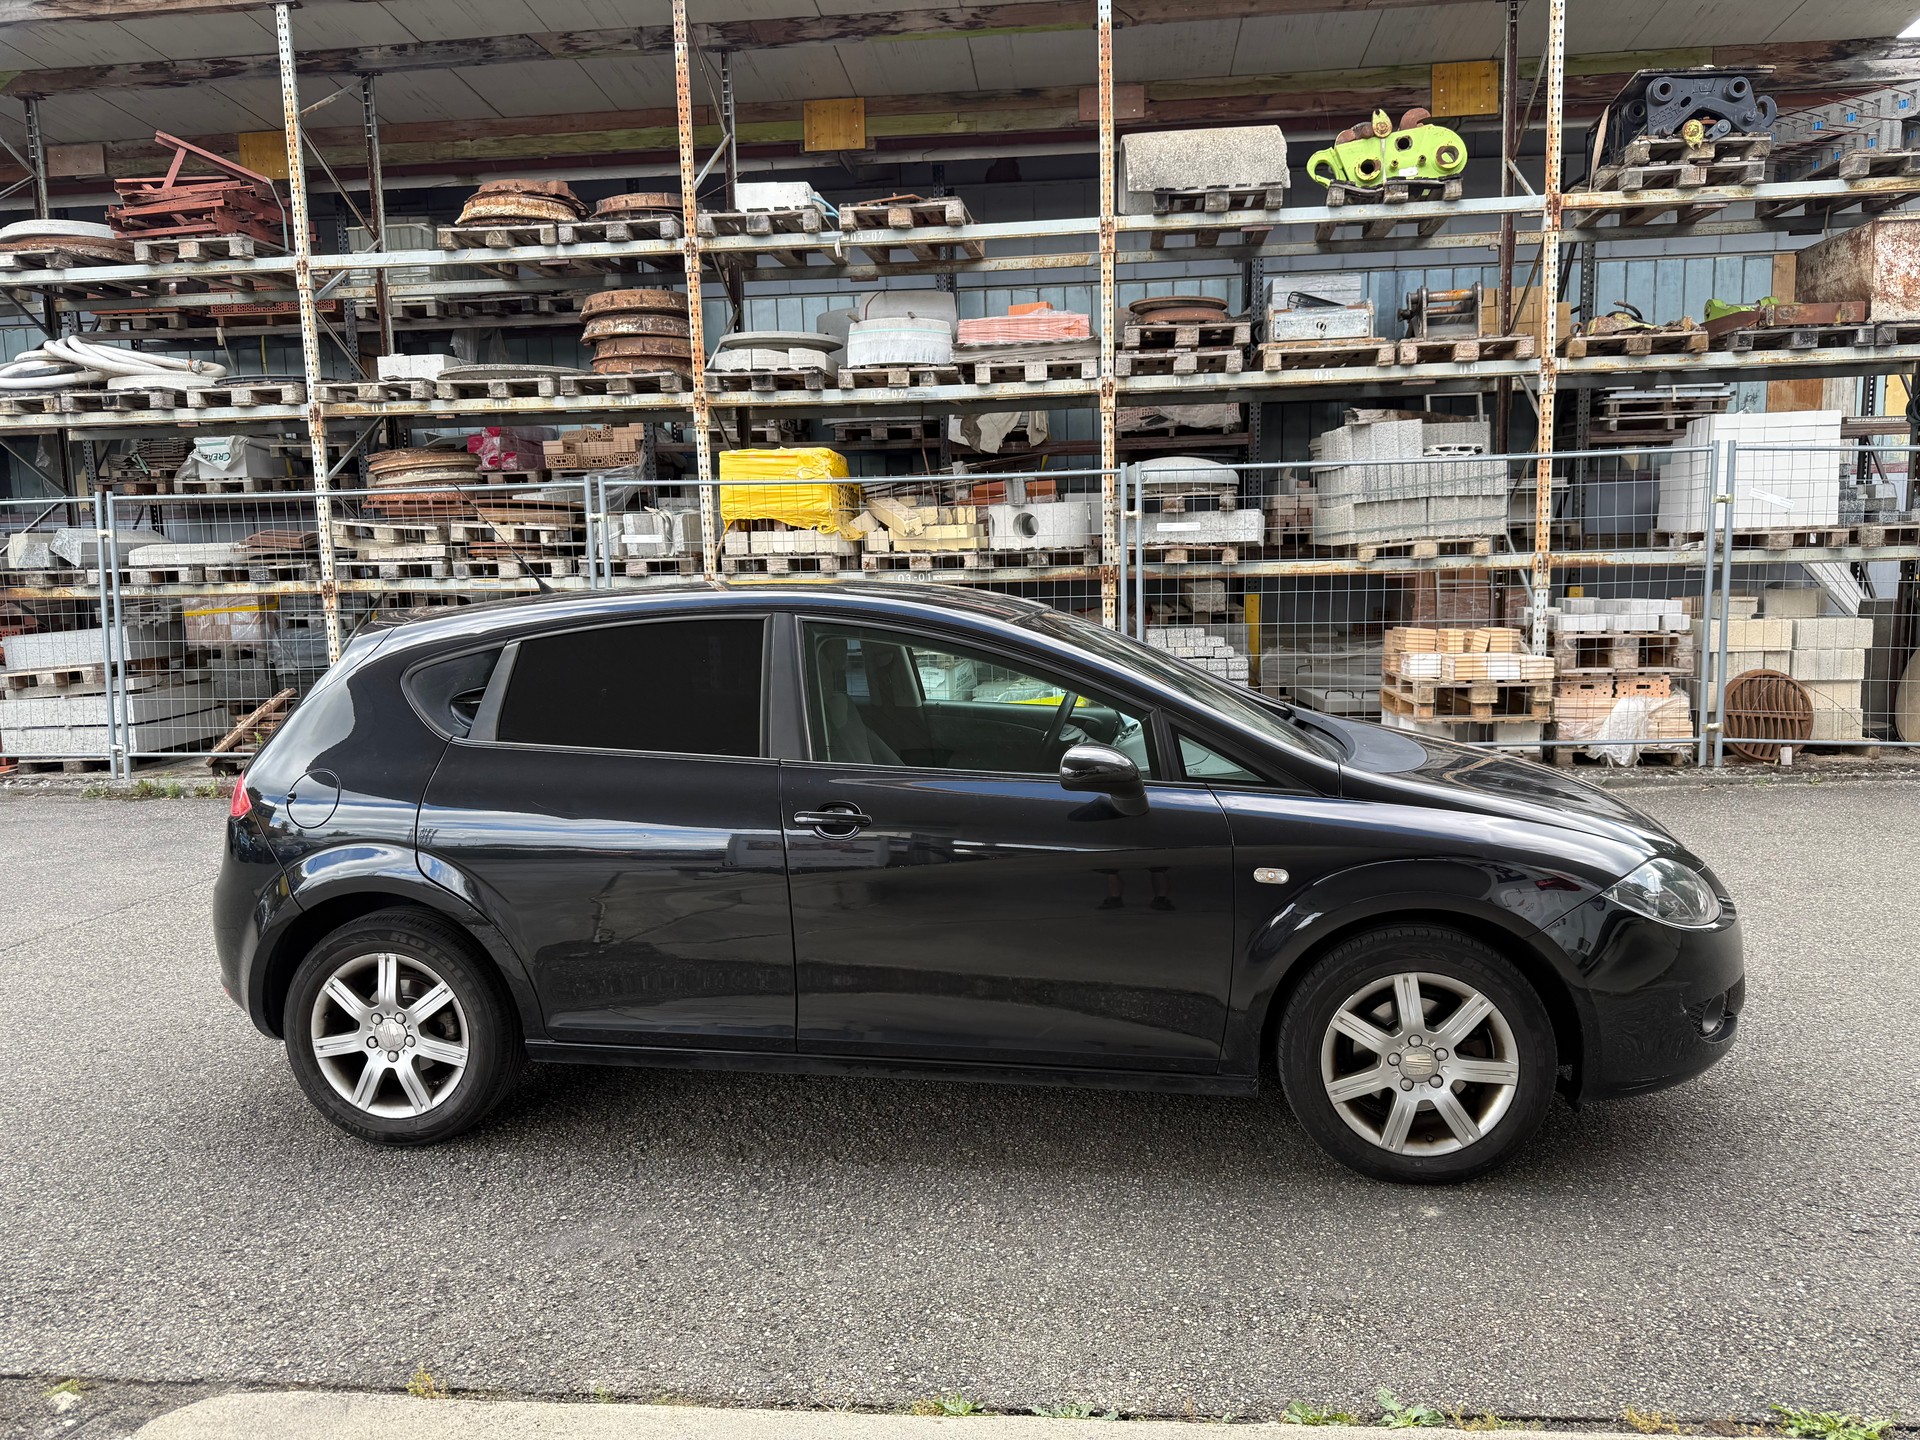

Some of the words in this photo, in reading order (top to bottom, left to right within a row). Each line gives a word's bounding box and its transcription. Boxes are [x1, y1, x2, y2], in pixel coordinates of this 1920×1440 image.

[1459, 363, 1479, 374] 09
[1173, 376, 1191, 387] 07
[897, 572, 932, 583] 03-01
[133, 586, 164, 596] 02-03
